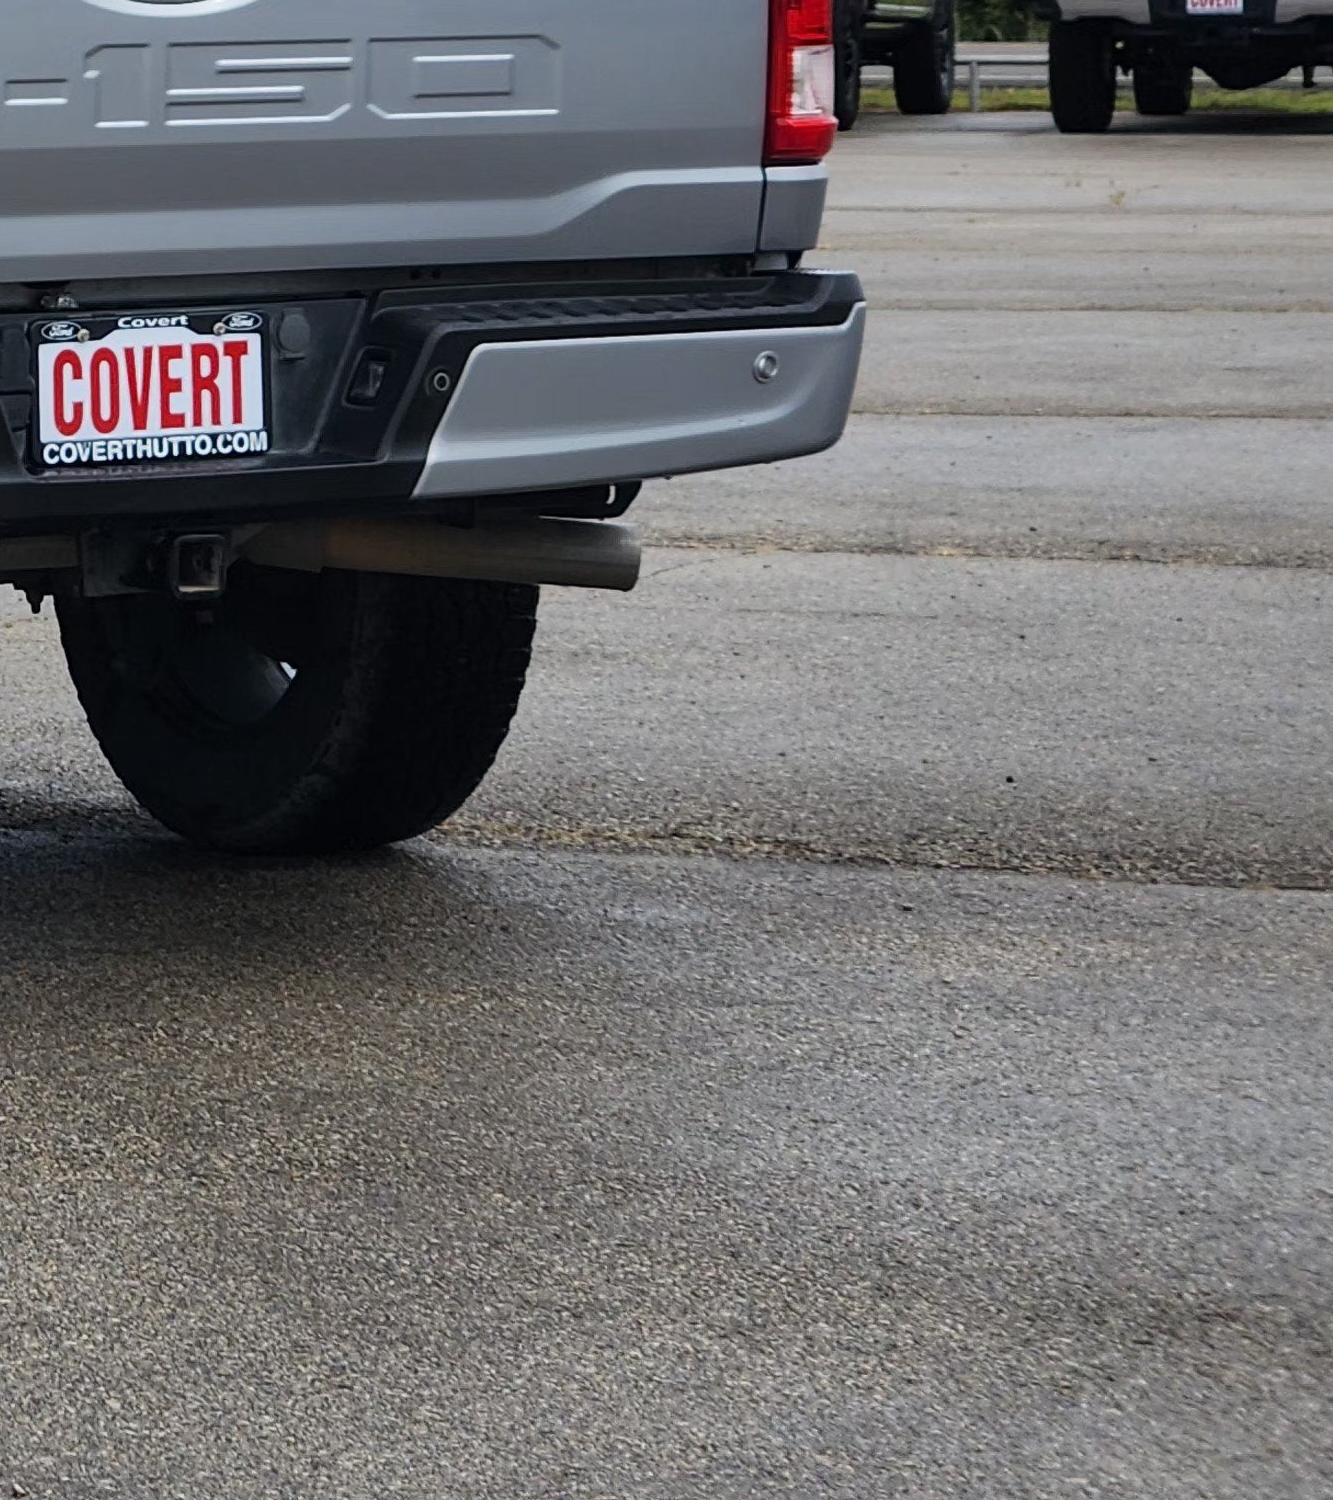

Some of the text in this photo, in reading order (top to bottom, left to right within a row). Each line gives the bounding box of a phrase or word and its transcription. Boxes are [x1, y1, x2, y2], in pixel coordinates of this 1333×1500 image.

[117, 315, 190, 329] Covert
[53, 341, 248, 436] COVERT
[43, 431, 268, 464] COVERTHUTTO.COM
